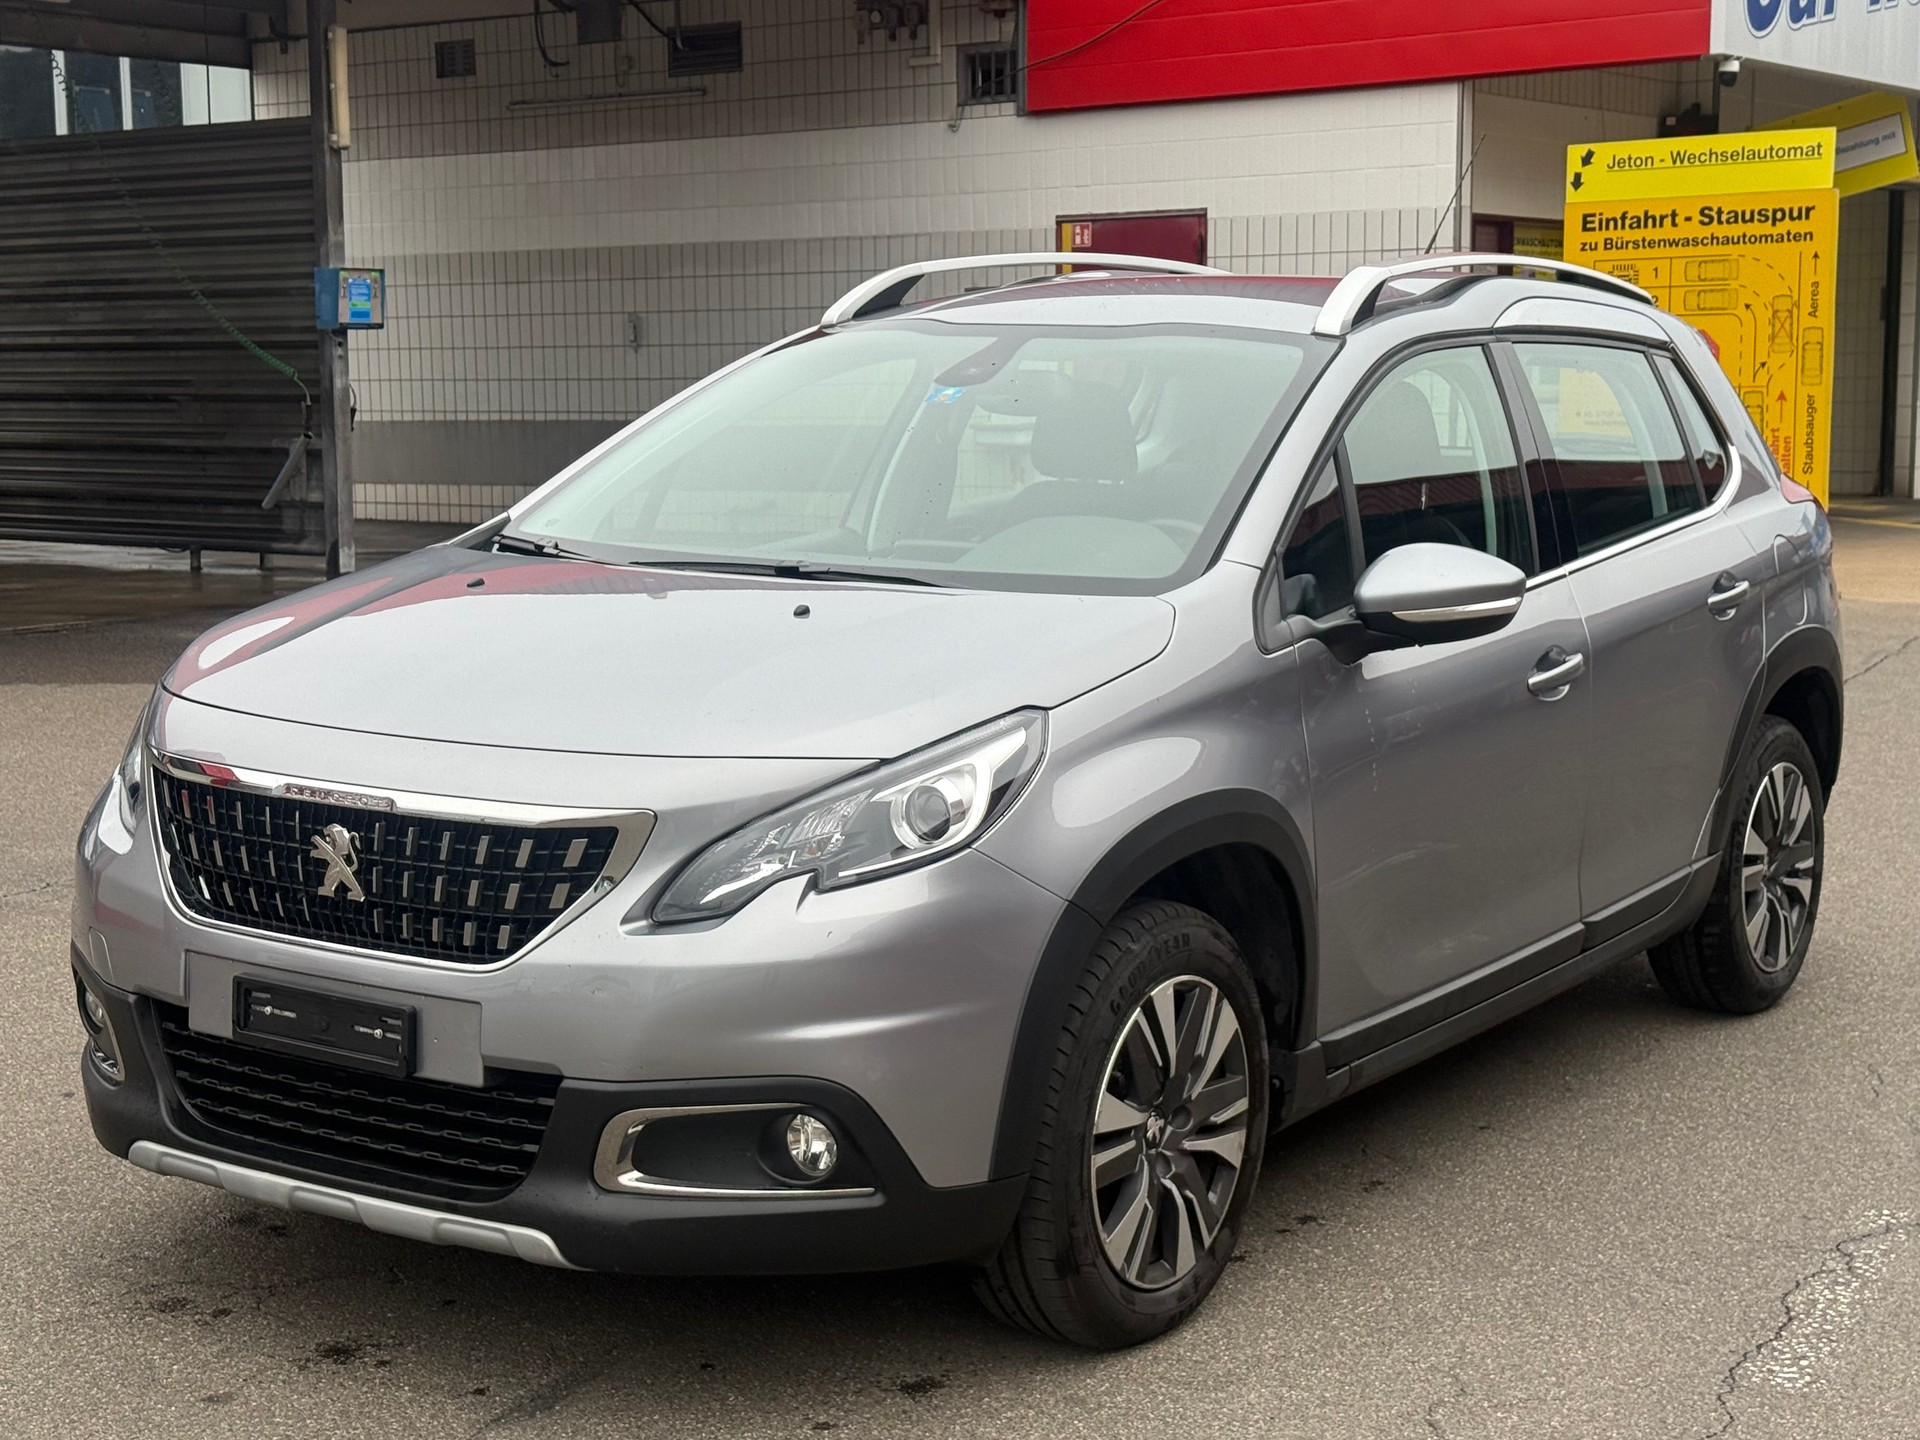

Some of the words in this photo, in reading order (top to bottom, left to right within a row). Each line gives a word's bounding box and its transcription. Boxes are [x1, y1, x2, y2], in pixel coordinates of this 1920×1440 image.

[1606, 154, 1654, 170] Jeton
[1670, 141, 1823, 166] Wechselautomat
[1581, 208, 1679, 233] Einfahrt
[1698, 205, 1816, 227] Stauspur
[1580, 241, 1598, 252] zu
[1603, 229, 1814, 251] Bürstenwaschautomaten
[1652, 266, 1659, 279] 1
[1808, 281, 1820, 318] Aerea
[1802, 393, 1817, 475] Staubsauger
